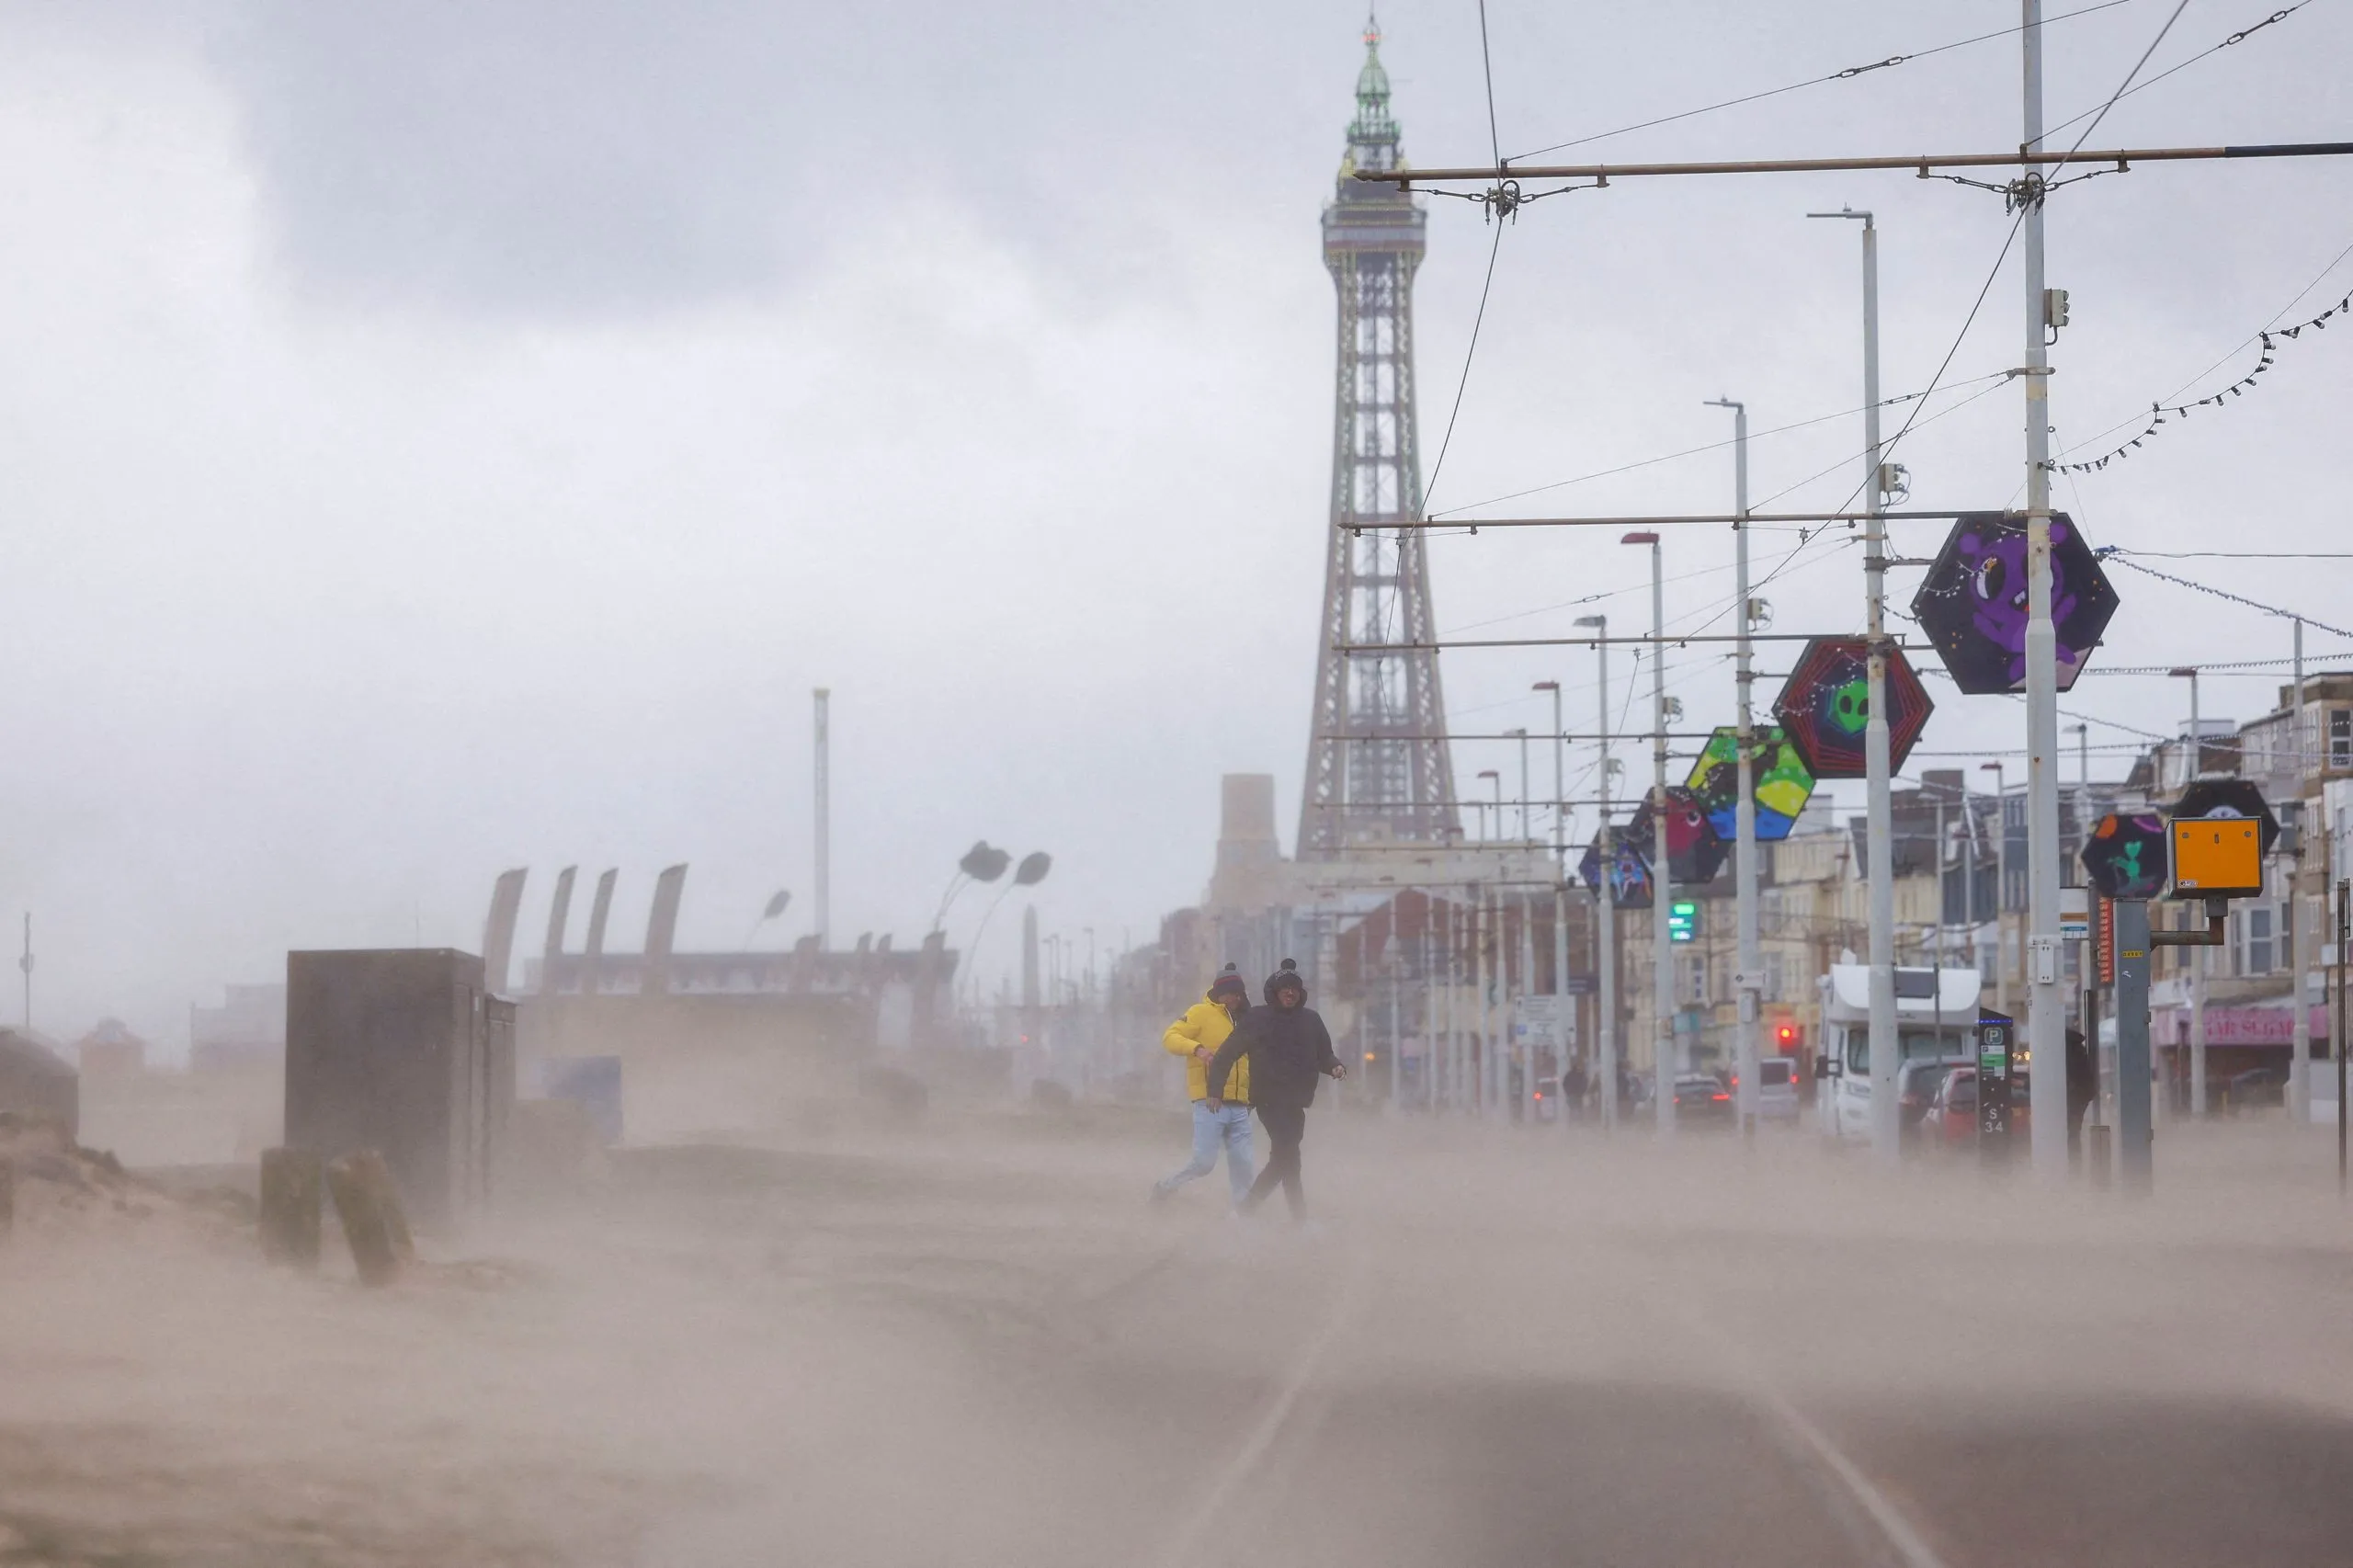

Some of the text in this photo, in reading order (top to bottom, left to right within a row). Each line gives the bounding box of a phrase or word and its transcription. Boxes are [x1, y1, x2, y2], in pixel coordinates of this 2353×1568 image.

[1989, 1029, 1999, 1042] P
[1989, 1108, 1998, 1119] S
[1984, 1120, 2004, 1133] 34
